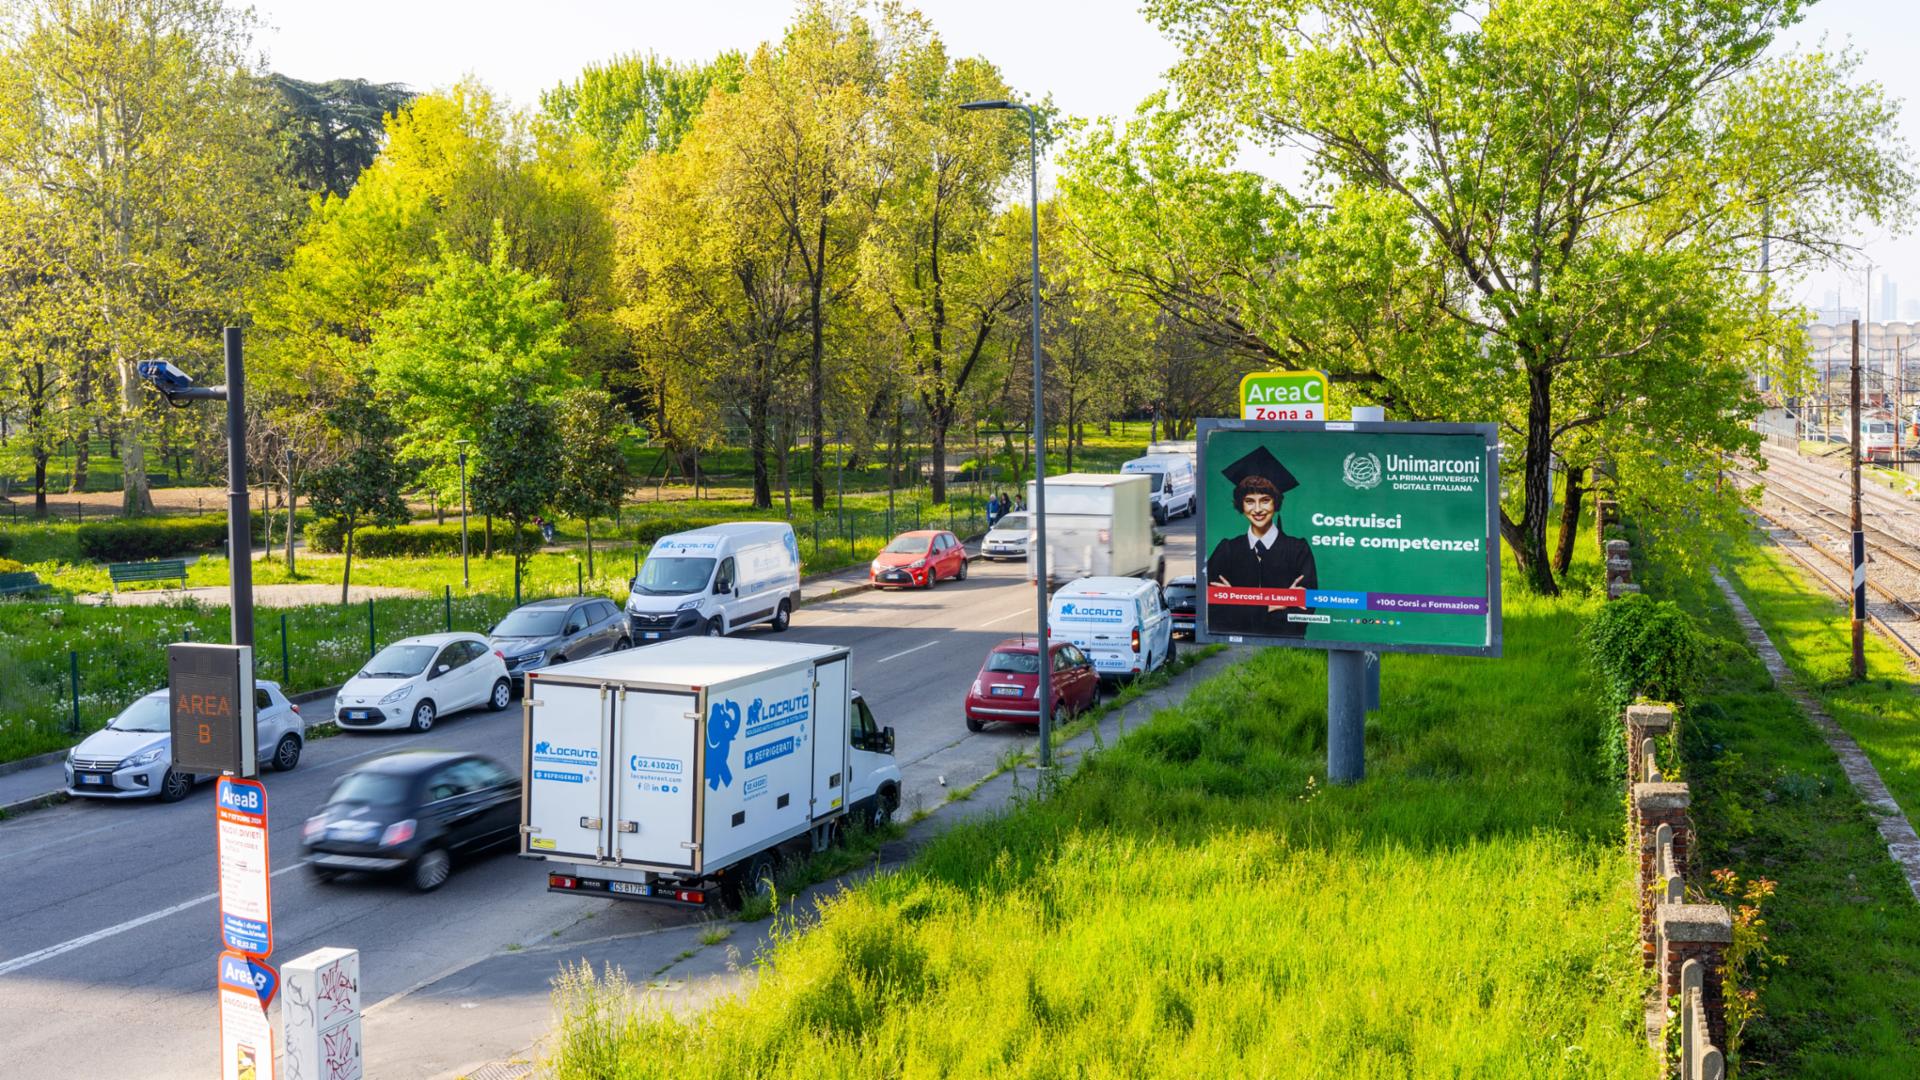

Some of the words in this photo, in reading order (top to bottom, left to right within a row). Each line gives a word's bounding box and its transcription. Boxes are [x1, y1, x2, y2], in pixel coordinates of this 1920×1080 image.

[1256, 408, 1298, 420] Zona
[1304, 410, 1314, 420] a
[1386, 454, 1480, 474] Unimarconi
[1429, 475, 1480, 484] UNIVERSITÀ
[1393, 483, 1431, 491] DIGITALE
[1433, 484, 1473, 492] ITALIANA
[1311, 512, 1402, 529] Costruisci
[1311, 532, 1356, 547] serie
[1360, 537, 1480, 552] competenze!
[1214, 592, 1228, 600] +50
[1230, 592, 1263, 601] Percorsi
[1330, 597, 1360, 605] Master
[1398, 599, 1420, 607] Corsi
[1429, 601, 1480, 610] Formazione
[1075, 608, 1123, 617] LOCAUTO
[176, 693, 232, 716] AREA
[762, 694, 809, 720] LOCAUTO
[199, 723, 212, 744] B
[550, 747, 598, 758] LOCAUTO
[754, 741, 792, 761] REFRIGERATI
[638, 760, 679, 771] 02.430201
[222, 786, 259, 809] AreaB
